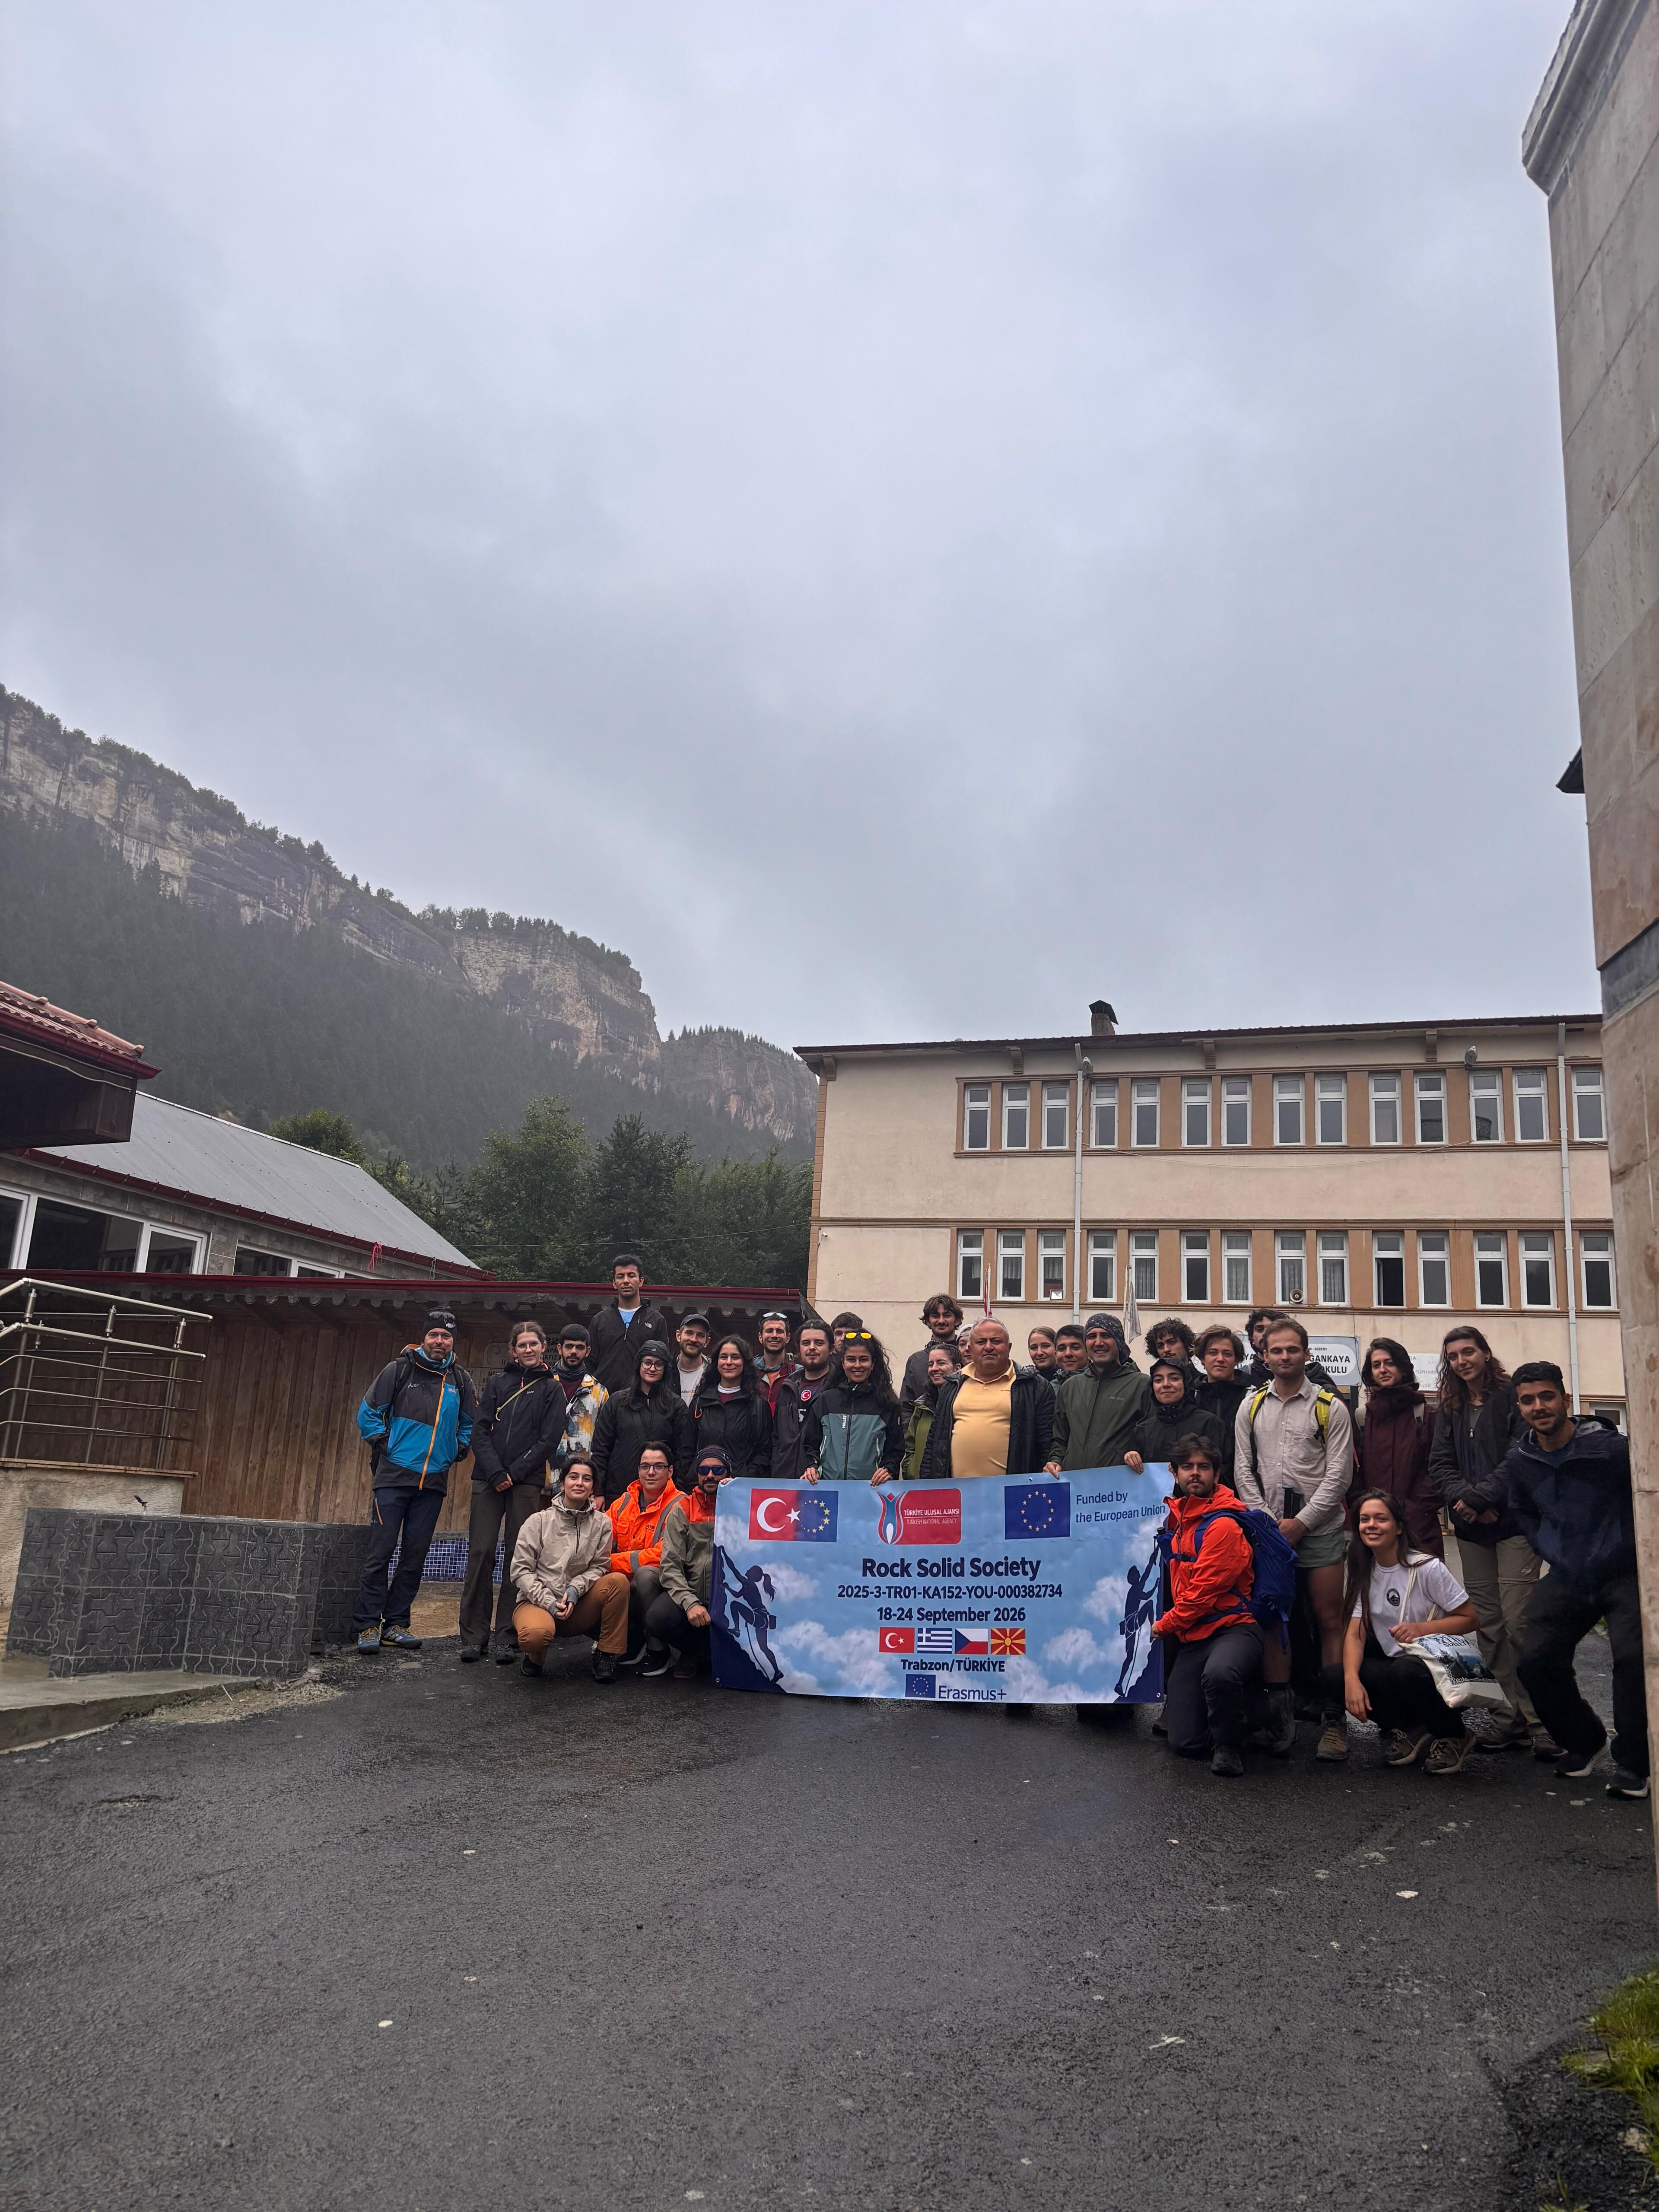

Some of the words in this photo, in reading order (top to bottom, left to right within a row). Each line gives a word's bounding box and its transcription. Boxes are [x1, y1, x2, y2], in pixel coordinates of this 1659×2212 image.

[1309, 1353, 1351, 1363] ĞANKAYA
[1076, 1491, 1113, 1505] Funded
[1116, 1491, 1128, 1503] by
[1075, 1512, 1092, 1523] the
[1094, 1509, 1139, 1522] European
[1141, 1504, 1166, 1516] Union
[862, 1558, 912, 1577] Rock
[916, 1557, 965, 1577] Solid
[969, 1556, 1041, 1581] Society
[837, 1584, 1062, 1599] 2025-3-TR01-KA152-YOU-000382734
[877, 1607, 913, 1621] 18-24
[916, 1607, 991, 1624] September
[993, 1607, 1026, 1621] 2026
[900, 1657, 1005, 1672] Trabzon/TÜRKİYE
[938, 1685, 1007, 1700] Erasmus+
